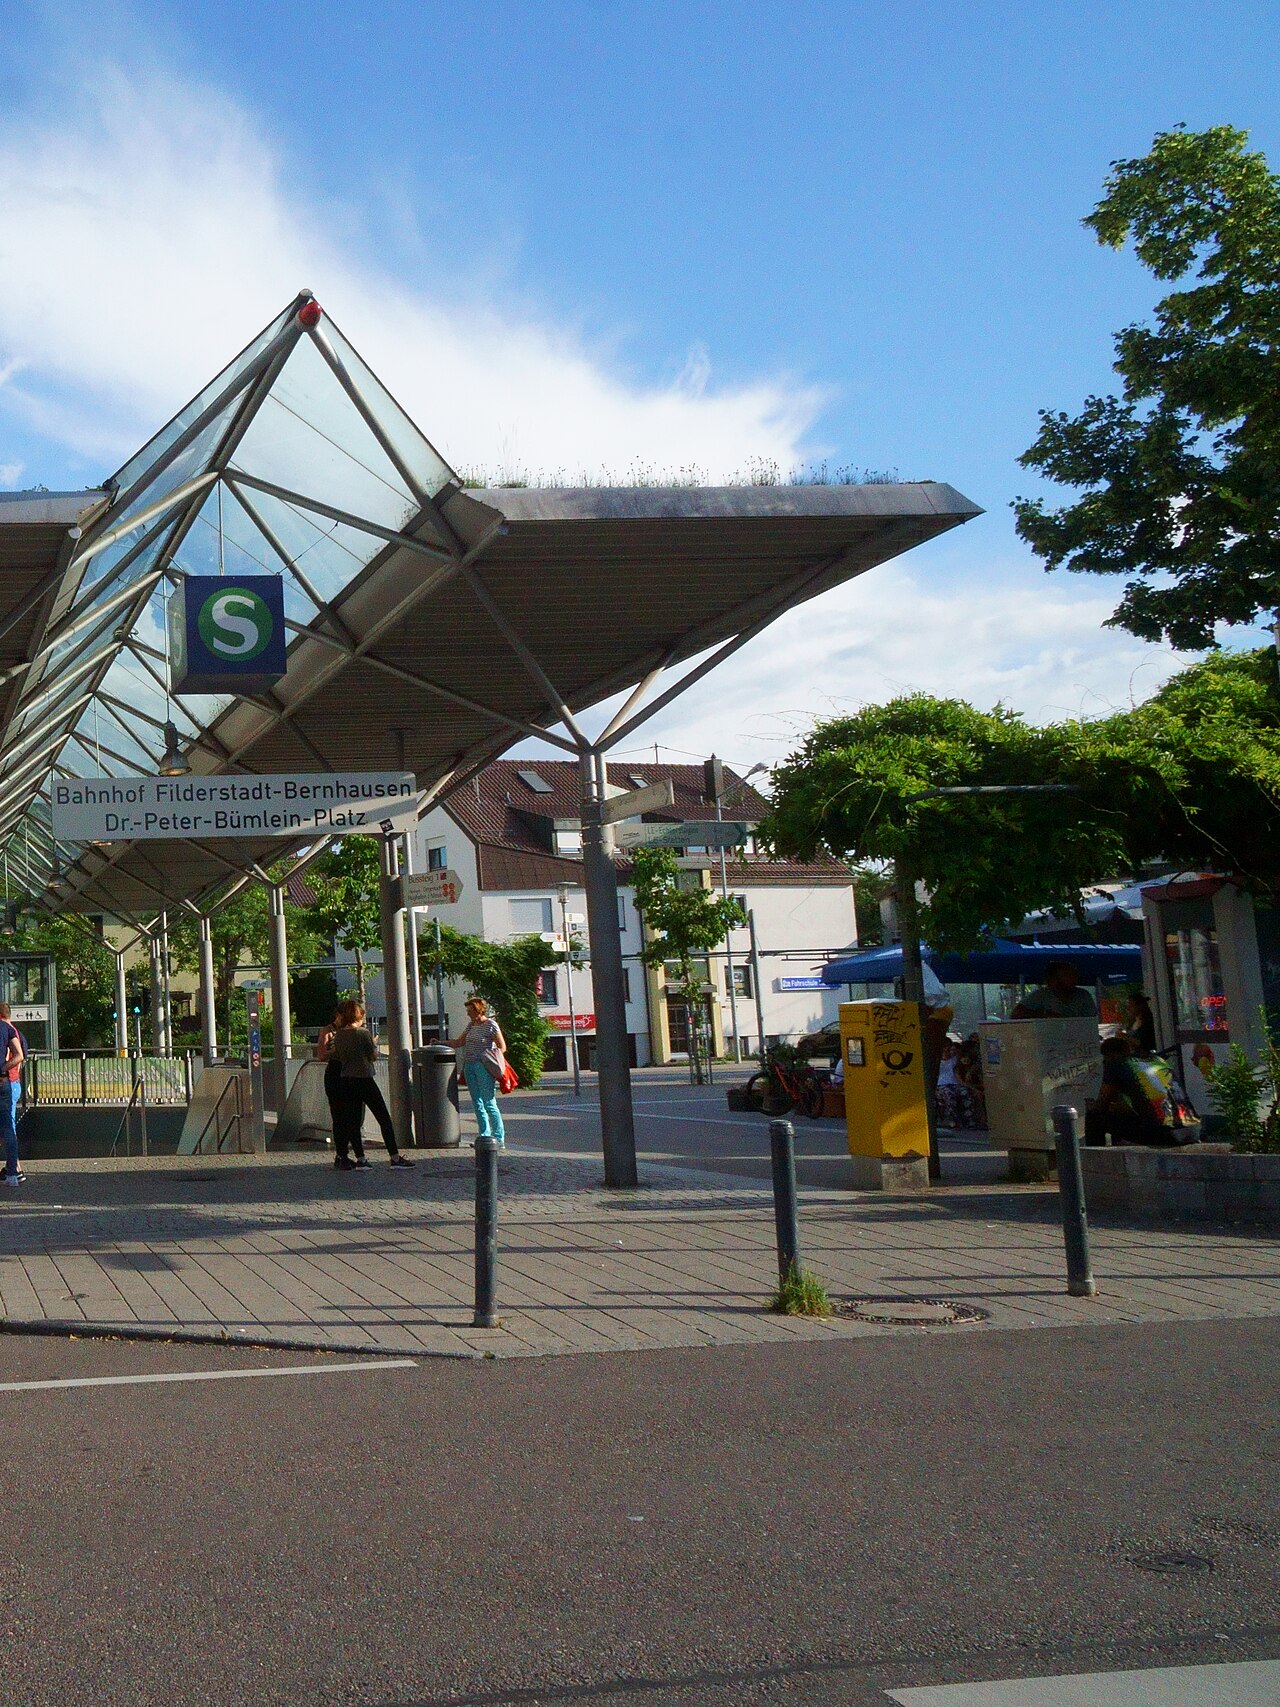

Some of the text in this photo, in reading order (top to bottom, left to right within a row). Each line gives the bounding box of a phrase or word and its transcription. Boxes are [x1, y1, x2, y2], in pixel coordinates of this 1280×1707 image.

[211, 595, 259, 655] S
[56, 780, 412, 805] Bahnhof Filderstadt-Bernhausen
[105, 808, 367, 832] Dr.-Peter-Bümlein-Platz
